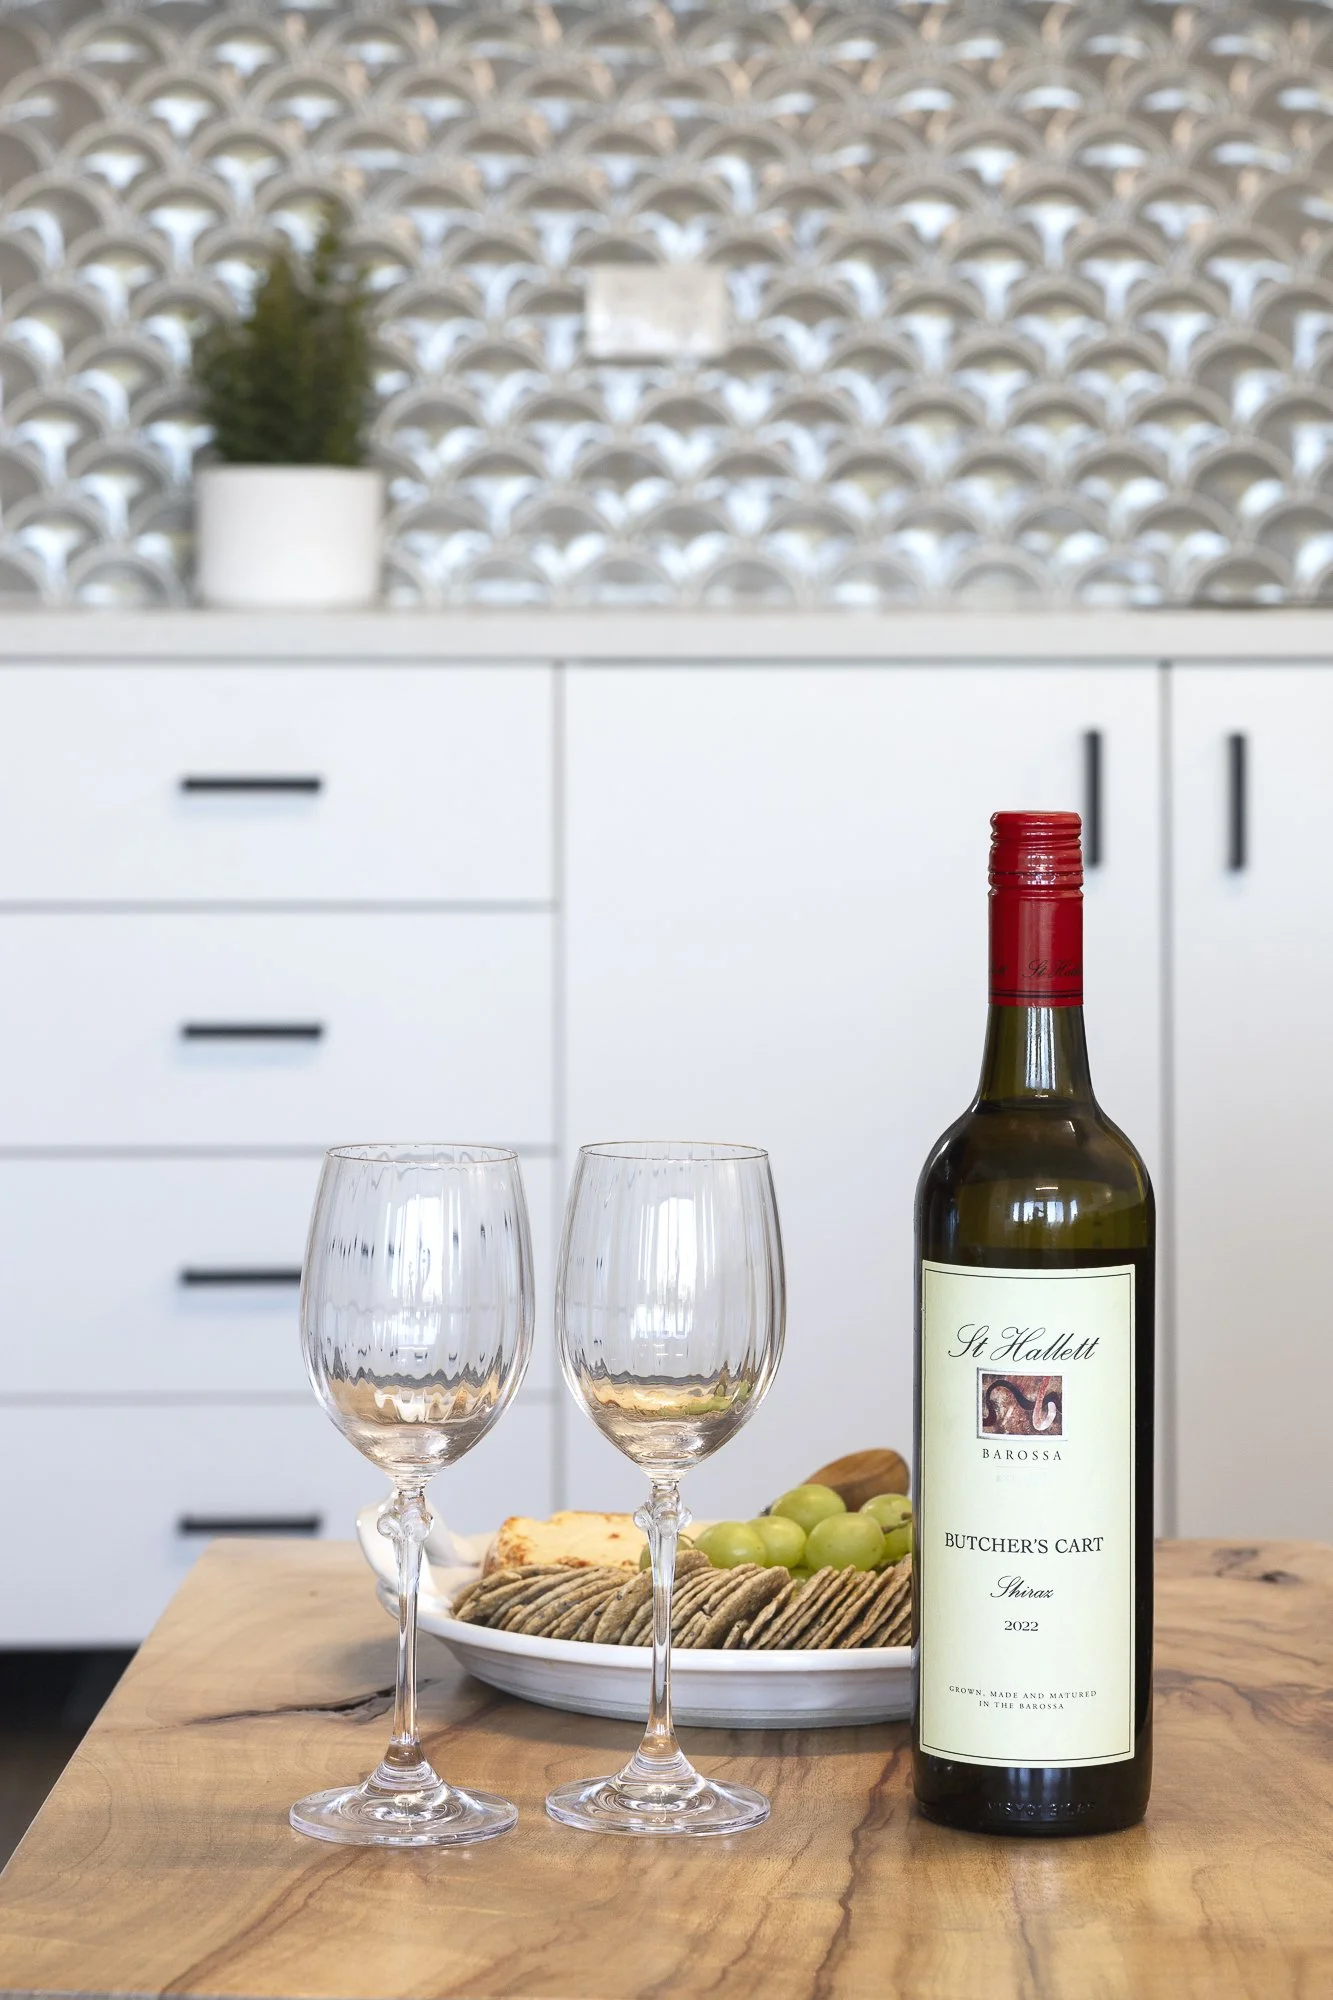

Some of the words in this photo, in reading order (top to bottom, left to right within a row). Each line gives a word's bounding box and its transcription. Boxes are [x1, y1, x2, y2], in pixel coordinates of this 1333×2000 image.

[948, 1323, 990, 1358] St
[989, 1326, 1101, 1362] Hallett
[982, 1448, 1062, 1461] BAROSSA
[944, 1532, 1049, 1554] BUTCHER'S
[1054, 1536, 1105, 1554] CART
[989, 1575, 1055, 1599] Shiraz
[1003, 1620, 1039, 1632] 2022
[989, 1690, 1019, 1699] MADE
[1022, 1692, 1045, 1700] AND
[1049, 1690, 1098, 1700] MATURED
[978, 1700, 990, 1708] IN
[994, 1701, 1014, 1709] THE
